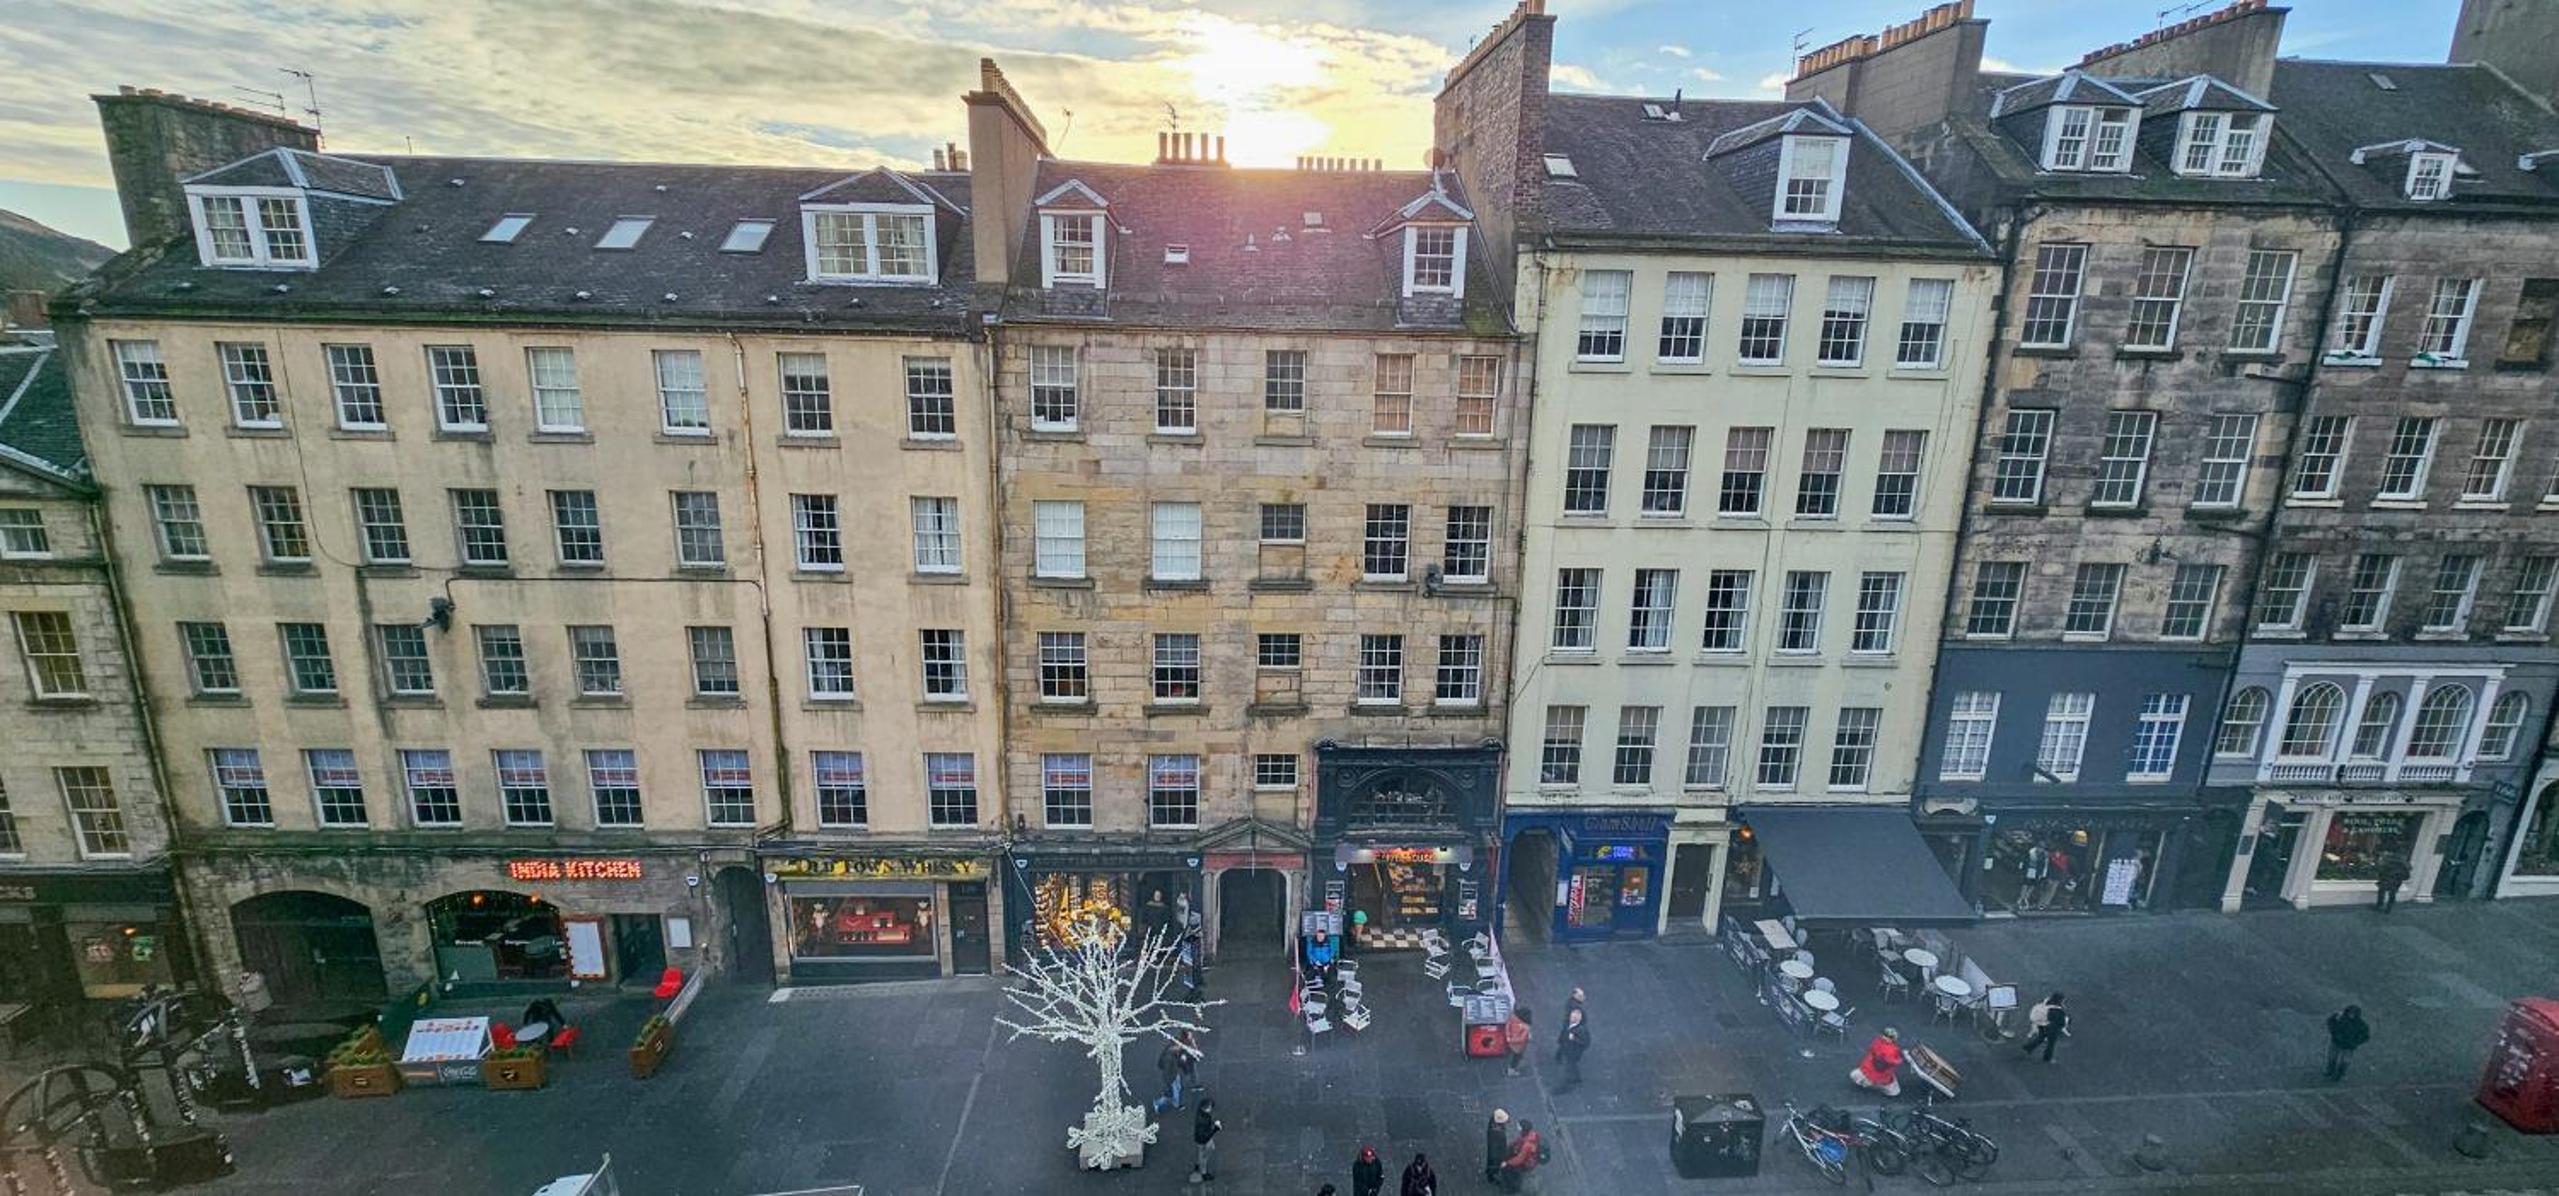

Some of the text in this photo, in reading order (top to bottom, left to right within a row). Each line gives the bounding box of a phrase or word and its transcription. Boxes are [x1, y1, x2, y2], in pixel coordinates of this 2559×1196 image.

[510, 860, 642, 879] INDIA KITCHEN
[800, 857, 972, 874] OLD TOWN WHISKY
